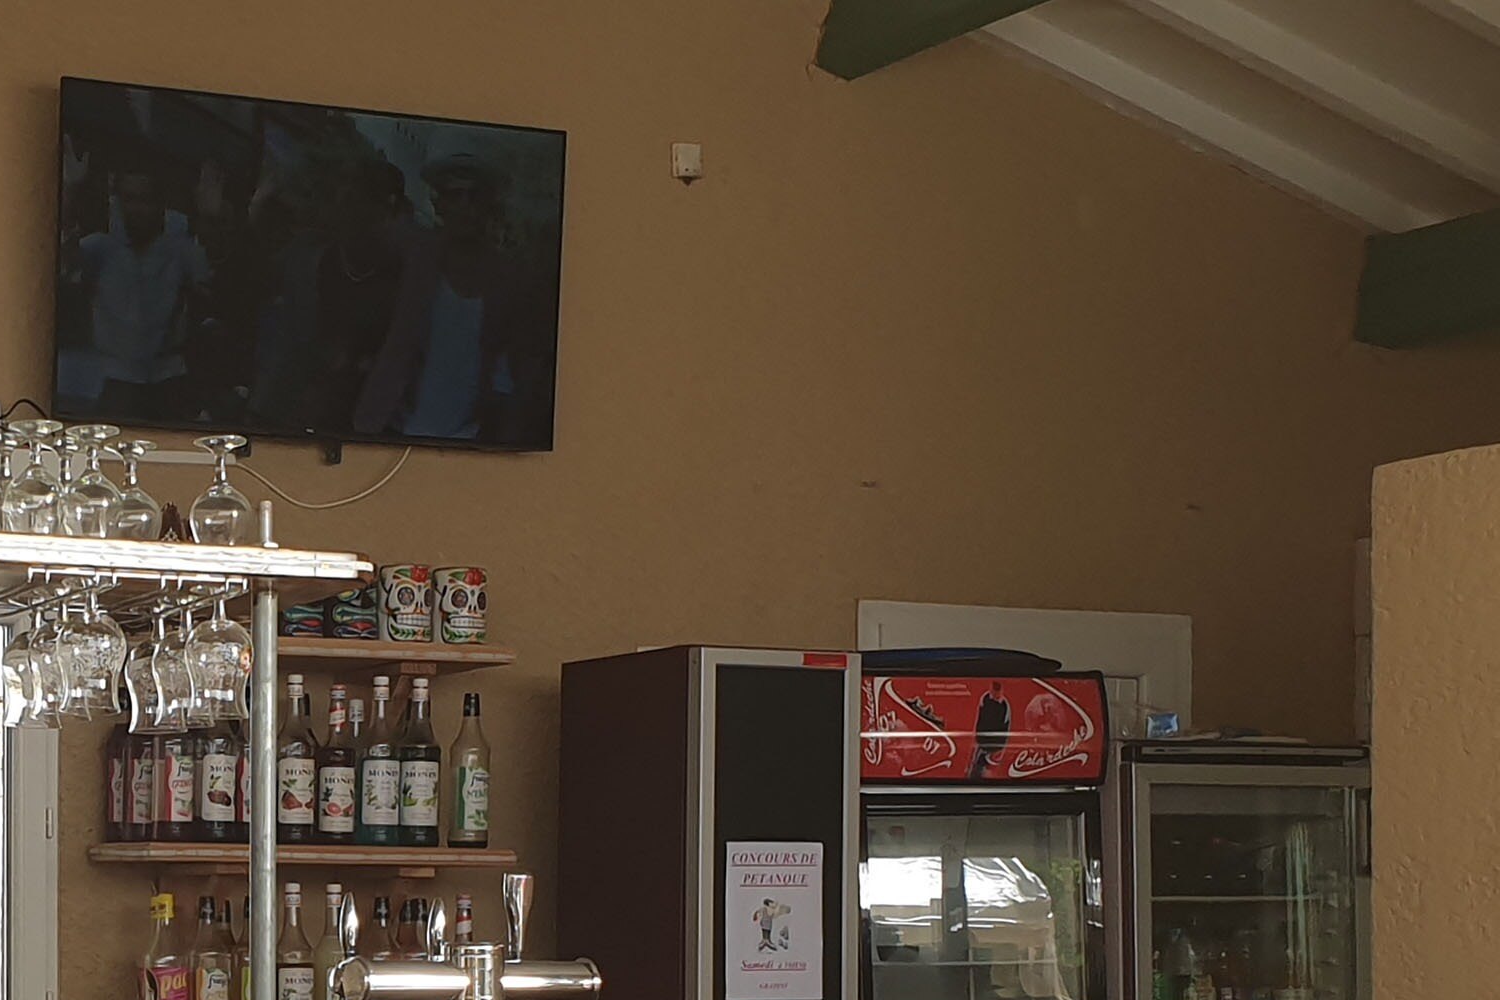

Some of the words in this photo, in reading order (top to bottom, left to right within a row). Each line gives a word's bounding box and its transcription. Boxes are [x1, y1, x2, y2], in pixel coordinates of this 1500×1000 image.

[731, 852, 797, 865] CONCOURS
[799, 852, 819, 865] DE
[743, 873, 809, 885] PETANQUE
